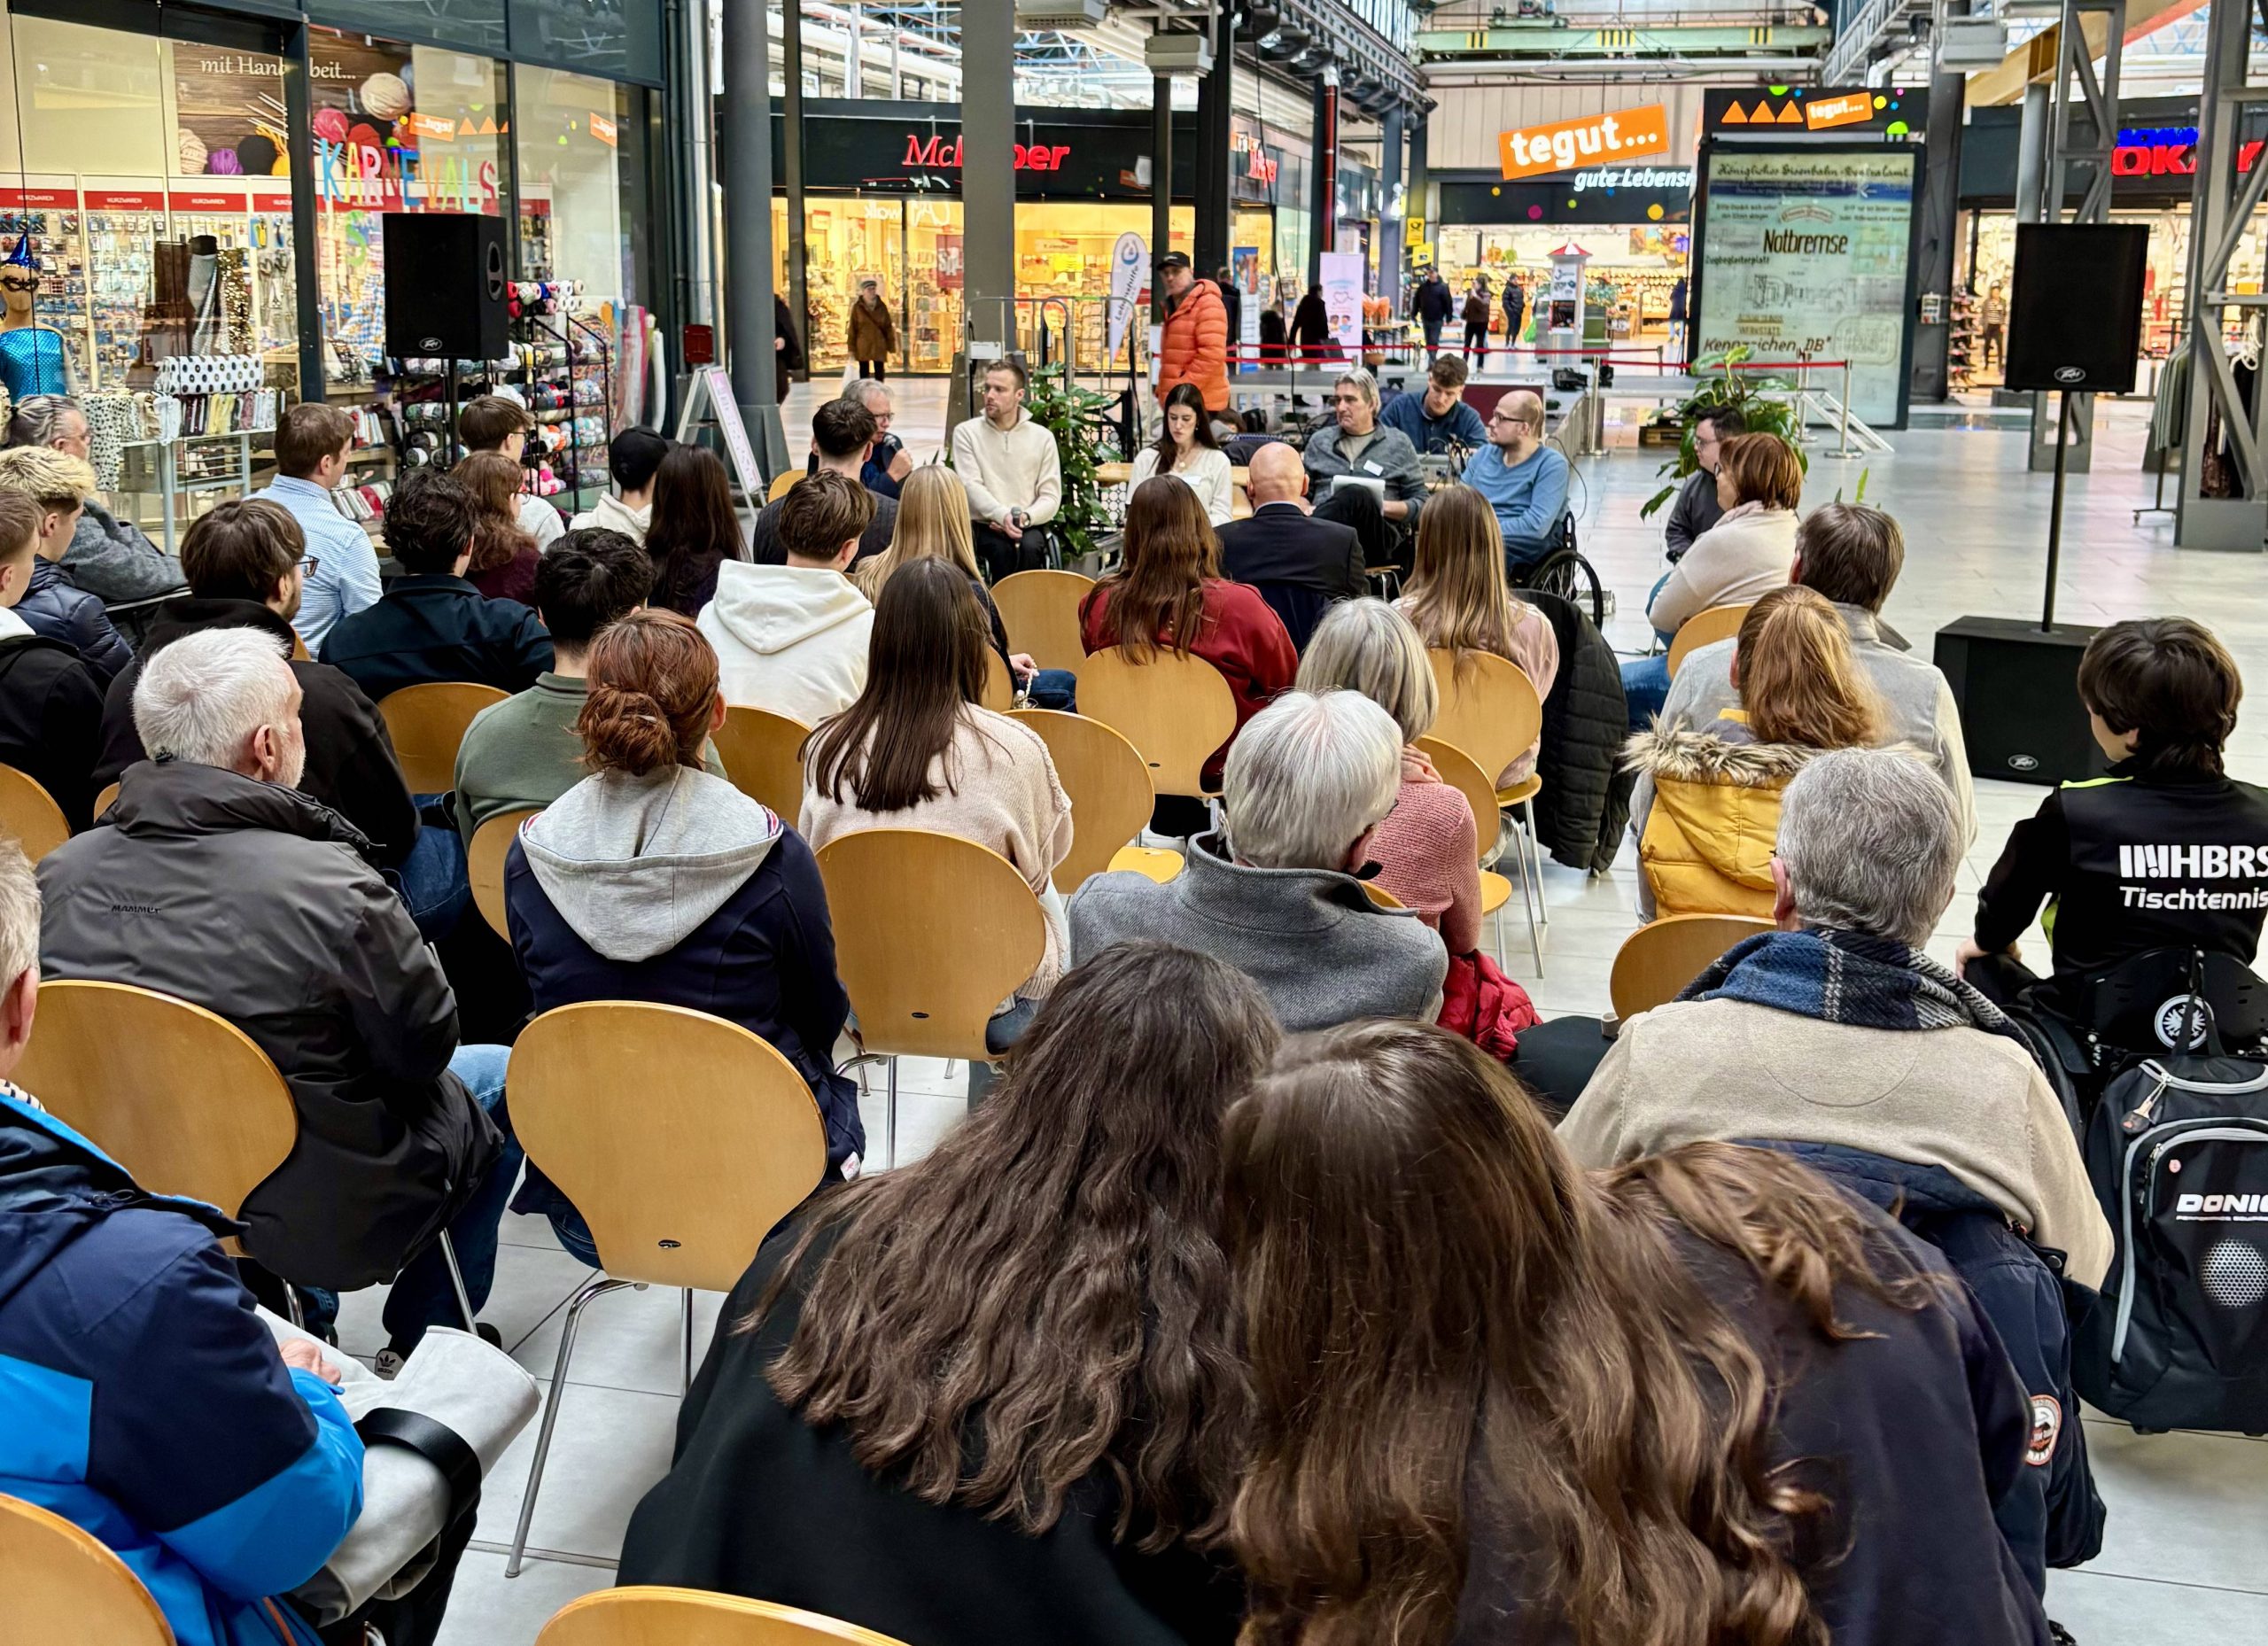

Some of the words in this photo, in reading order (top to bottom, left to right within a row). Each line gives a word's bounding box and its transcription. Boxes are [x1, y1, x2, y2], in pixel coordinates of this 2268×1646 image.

[200, 56, 233, 74] mit
[1809, 99, 1865, 120] tegut...
[1510, 116, 1658, 168] tegut...
[2111, 141, 2265, 176] OKY
[320, 137, 498, 214] KARNEVALS
[1573, 166, 1619, 192] gute
[1762, 228, 1849, 255] Notbremse
[111, 905, 162, 914] MAMMUT
[2119, 886, 2268, 911] Tischtennis
